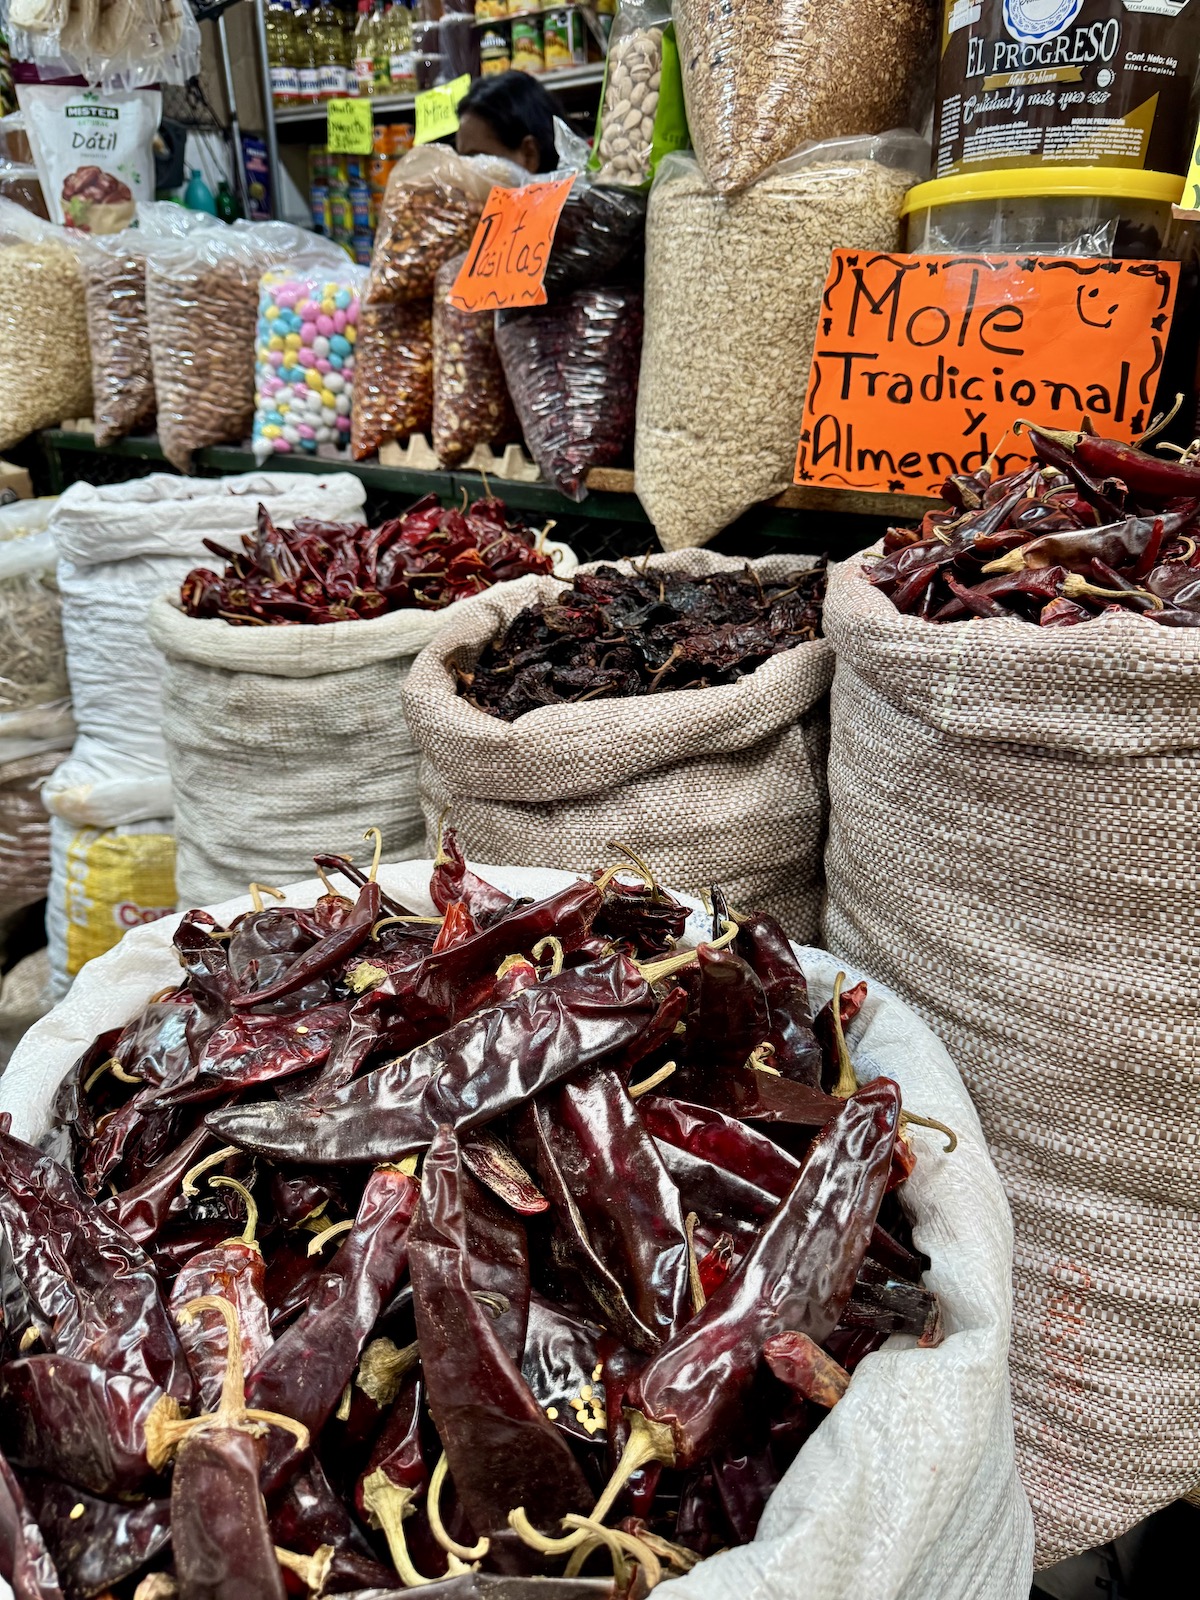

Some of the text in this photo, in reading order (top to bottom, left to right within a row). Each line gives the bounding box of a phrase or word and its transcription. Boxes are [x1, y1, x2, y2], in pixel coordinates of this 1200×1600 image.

[965, 18, 1119, 78] EL PROGRESO
[67, 107, 118, 119] MISTER
[72, 131, 118, 151] Dátil
[468, 209, 545, 278] Pasitas
[847, 268, 1024, 356] Mole
[818, 351, 1131, 422] Tradicional
[812, 414, 1043, 479] Almendr
[963, 408, 988, 437] y
